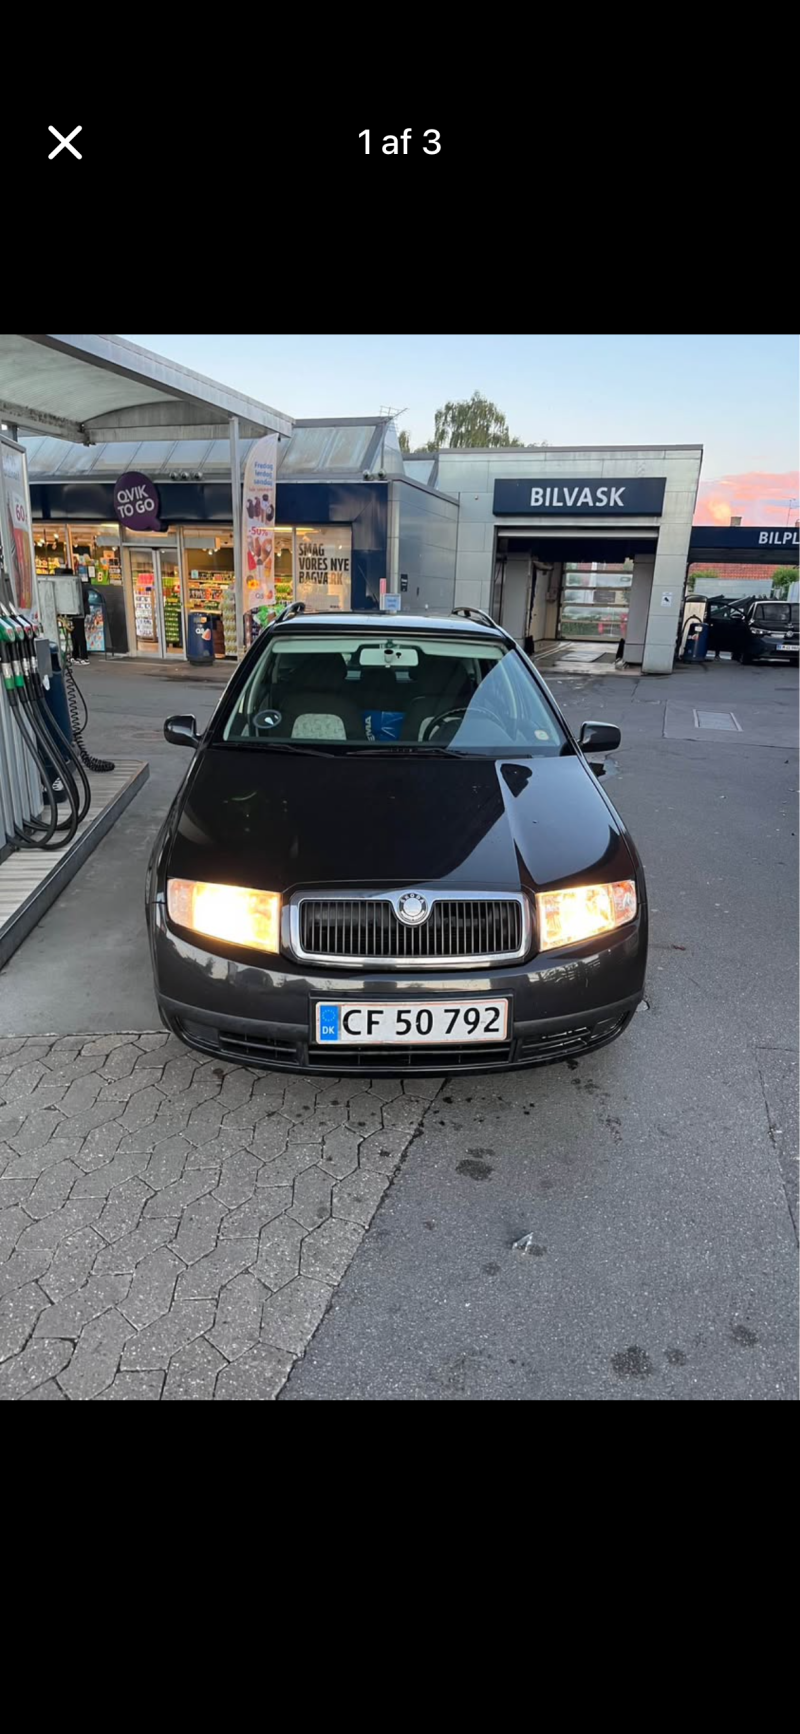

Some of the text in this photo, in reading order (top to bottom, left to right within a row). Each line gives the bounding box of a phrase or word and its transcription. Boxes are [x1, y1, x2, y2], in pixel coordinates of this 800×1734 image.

[117, 484, 149, 504] QVIK
[530, 487, 626, 507] BILVASK
[117, 498, 155, 519] TO GO
[758, 531, 800, 545] BILPL
[298, 543, 325, 557] SMAG
[298, 557, 350, 572] VORES NYE
[342, 1006, 501, 1036] CF 50 792
[322, 1025, 336, 1035] DK
